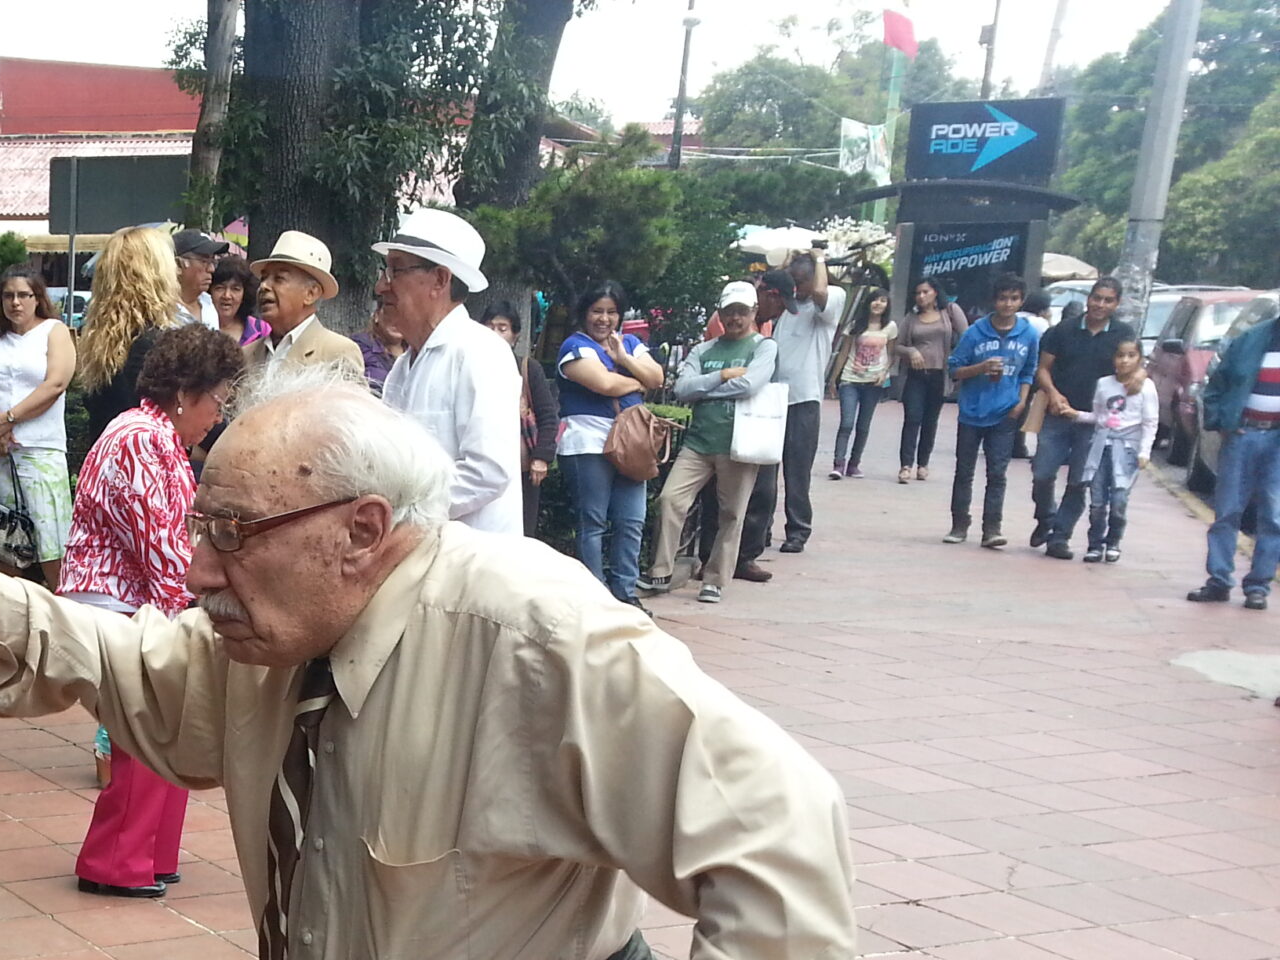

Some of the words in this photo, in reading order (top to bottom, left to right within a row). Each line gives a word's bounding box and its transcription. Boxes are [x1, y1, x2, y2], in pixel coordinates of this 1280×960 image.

[931, 121, 1019, 139] POWER
[929, 138, 978, 153] ADE
[923, 248, 1010, 277] #HAYPOWER
[974, 340, 1000, 356] AERO
[1007, 340, 1028, 356] NYC
